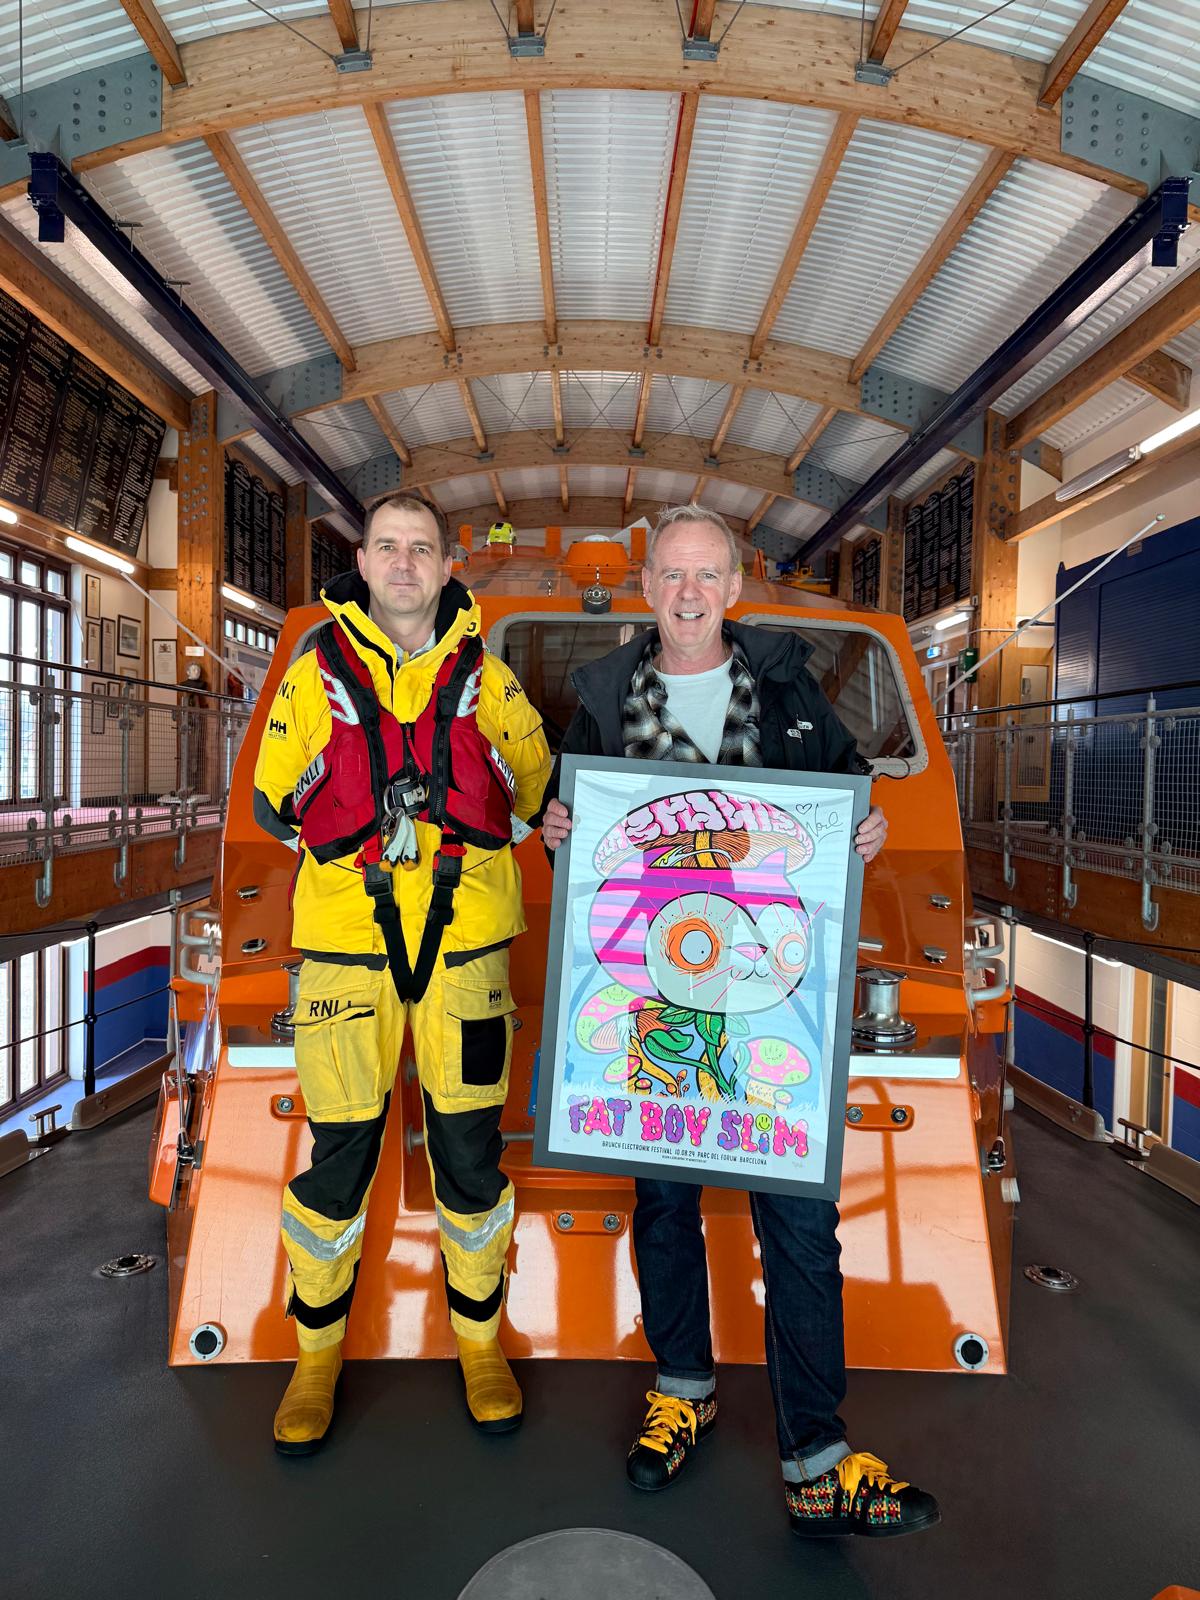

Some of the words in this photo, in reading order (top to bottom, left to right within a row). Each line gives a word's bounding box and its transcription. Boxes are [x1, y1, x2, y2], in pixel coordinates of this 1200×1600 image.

[567, 1094, 632, 1137] FAT
[639, 1100, 712, 1147] BOY
[602, 1140, 620, 1148] BRUNCH
[651, 1145, 672, 1155] FESTIVAL
[697, 1152, 710, 1160] PARC
[710, 1153, 720, 1161] DEL
[739, 1156, 768, 1166] BARCELONA
